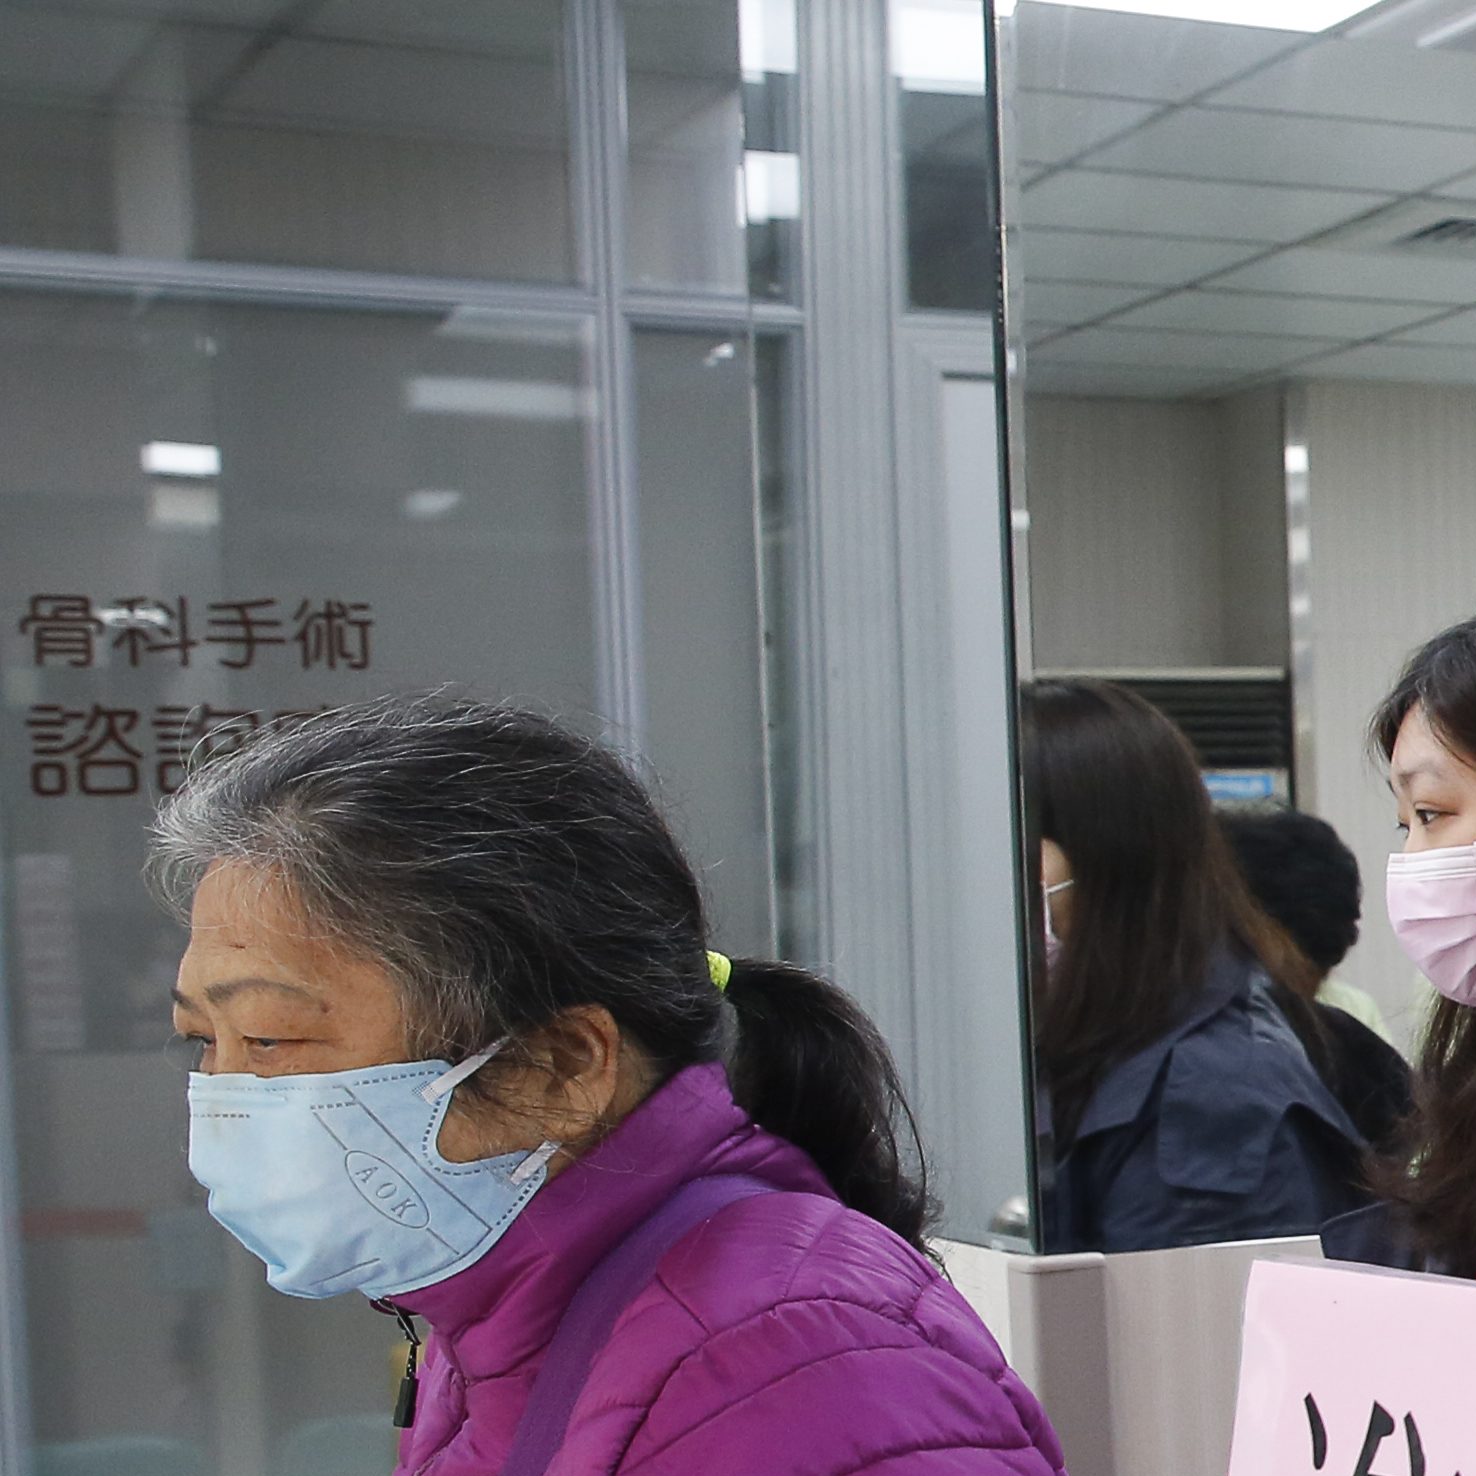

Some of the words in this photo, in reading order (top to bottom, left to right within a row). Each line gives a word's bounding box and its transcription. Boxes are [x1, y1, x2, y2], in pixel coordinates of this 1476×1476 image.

[19, 594, 376, 670] 骨科手術
[25, 703, 348, 796] 諮詢
[355, 1166, 418, 1219] AOK
